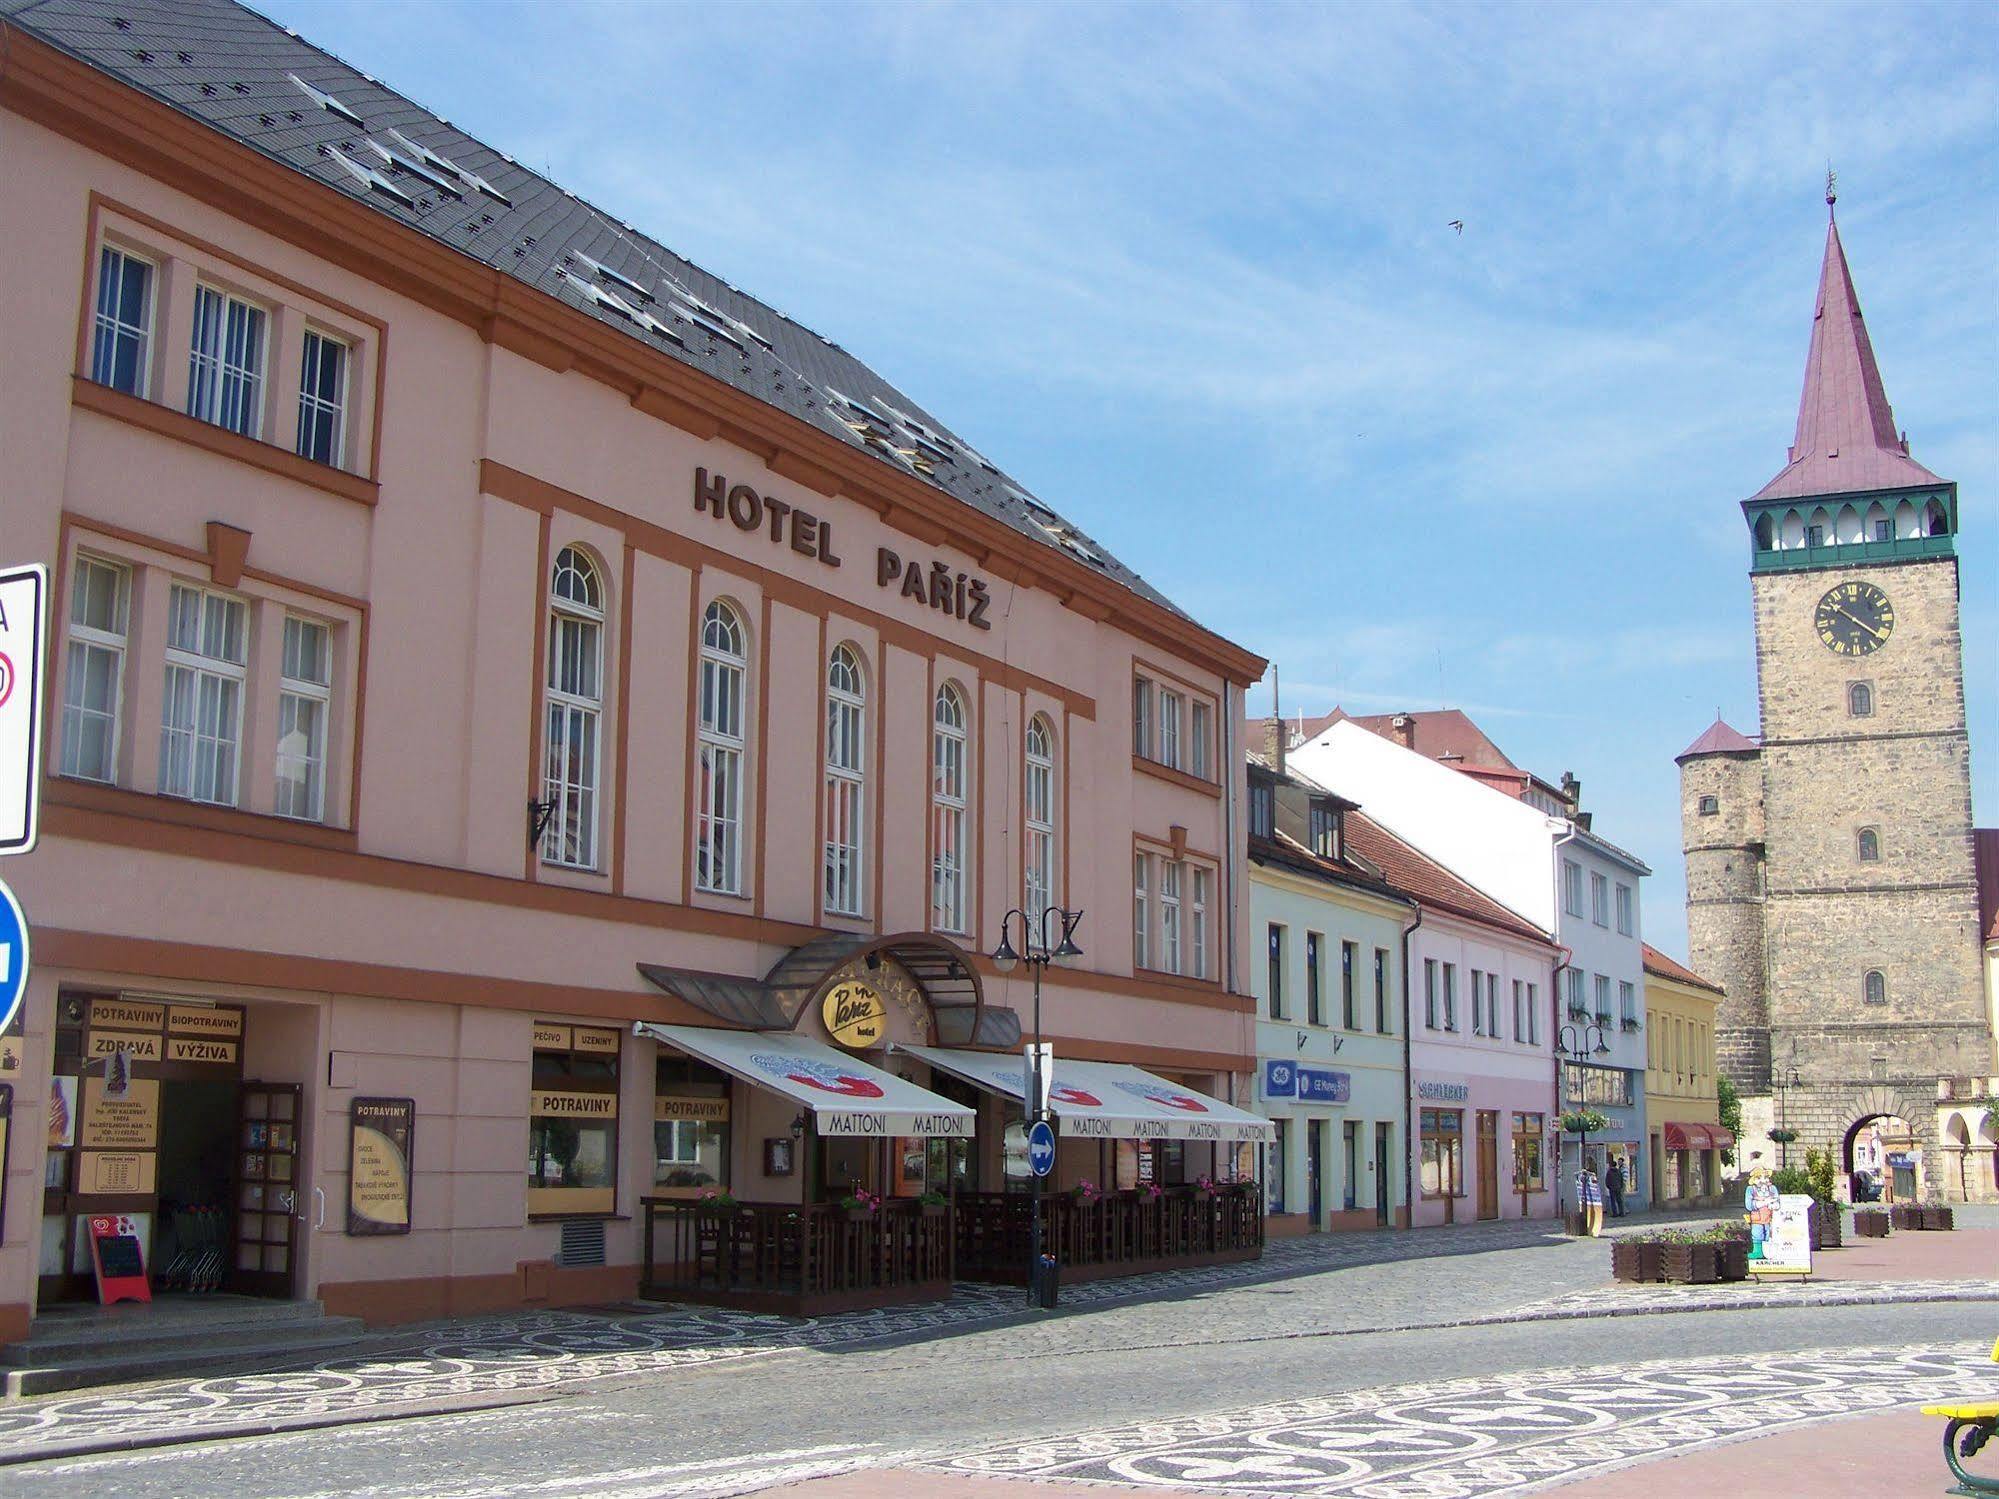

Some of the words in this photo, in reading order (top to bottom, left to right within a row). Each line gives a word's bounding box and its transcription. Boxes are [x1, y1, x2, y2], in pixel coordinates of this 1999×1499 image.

[694, 467, 841, 567] HOTEL
[878, 548, 991, 630] PAŘÍŽ
[93, 1007, 163, 1024] POTRAVINY
[171, 1015, 239, 1029] BIOPOTRAVINY
[534, 1031, 561, 1042] PEČÍVO
[857, 1026, 875, 1036] hotel
[95, 1039, 155, 1055] ZDRAVÁ
[582, 1035, 612, 1046] UZENINY
[176, 1042, 228, 1060] VÝŽIVA
[358, 1106, 406, 1117] POTRAVINY
[543, 1097, 611, 1113] POTRAVINY
[665, 1102, 724, 1116] POTRAVINY
[829, 1114, 886, 1133] MATTONI
[912, 1115, 963, 1133] MATTONI
[1073, 1118, 1112, 1135] MATTONI
[1133, 1120, 1169, 1137] MATTONI
[1188, 1122, 1221, 1138] MATTONI
[1237, 1125, 1266, 1139] MATTONI
